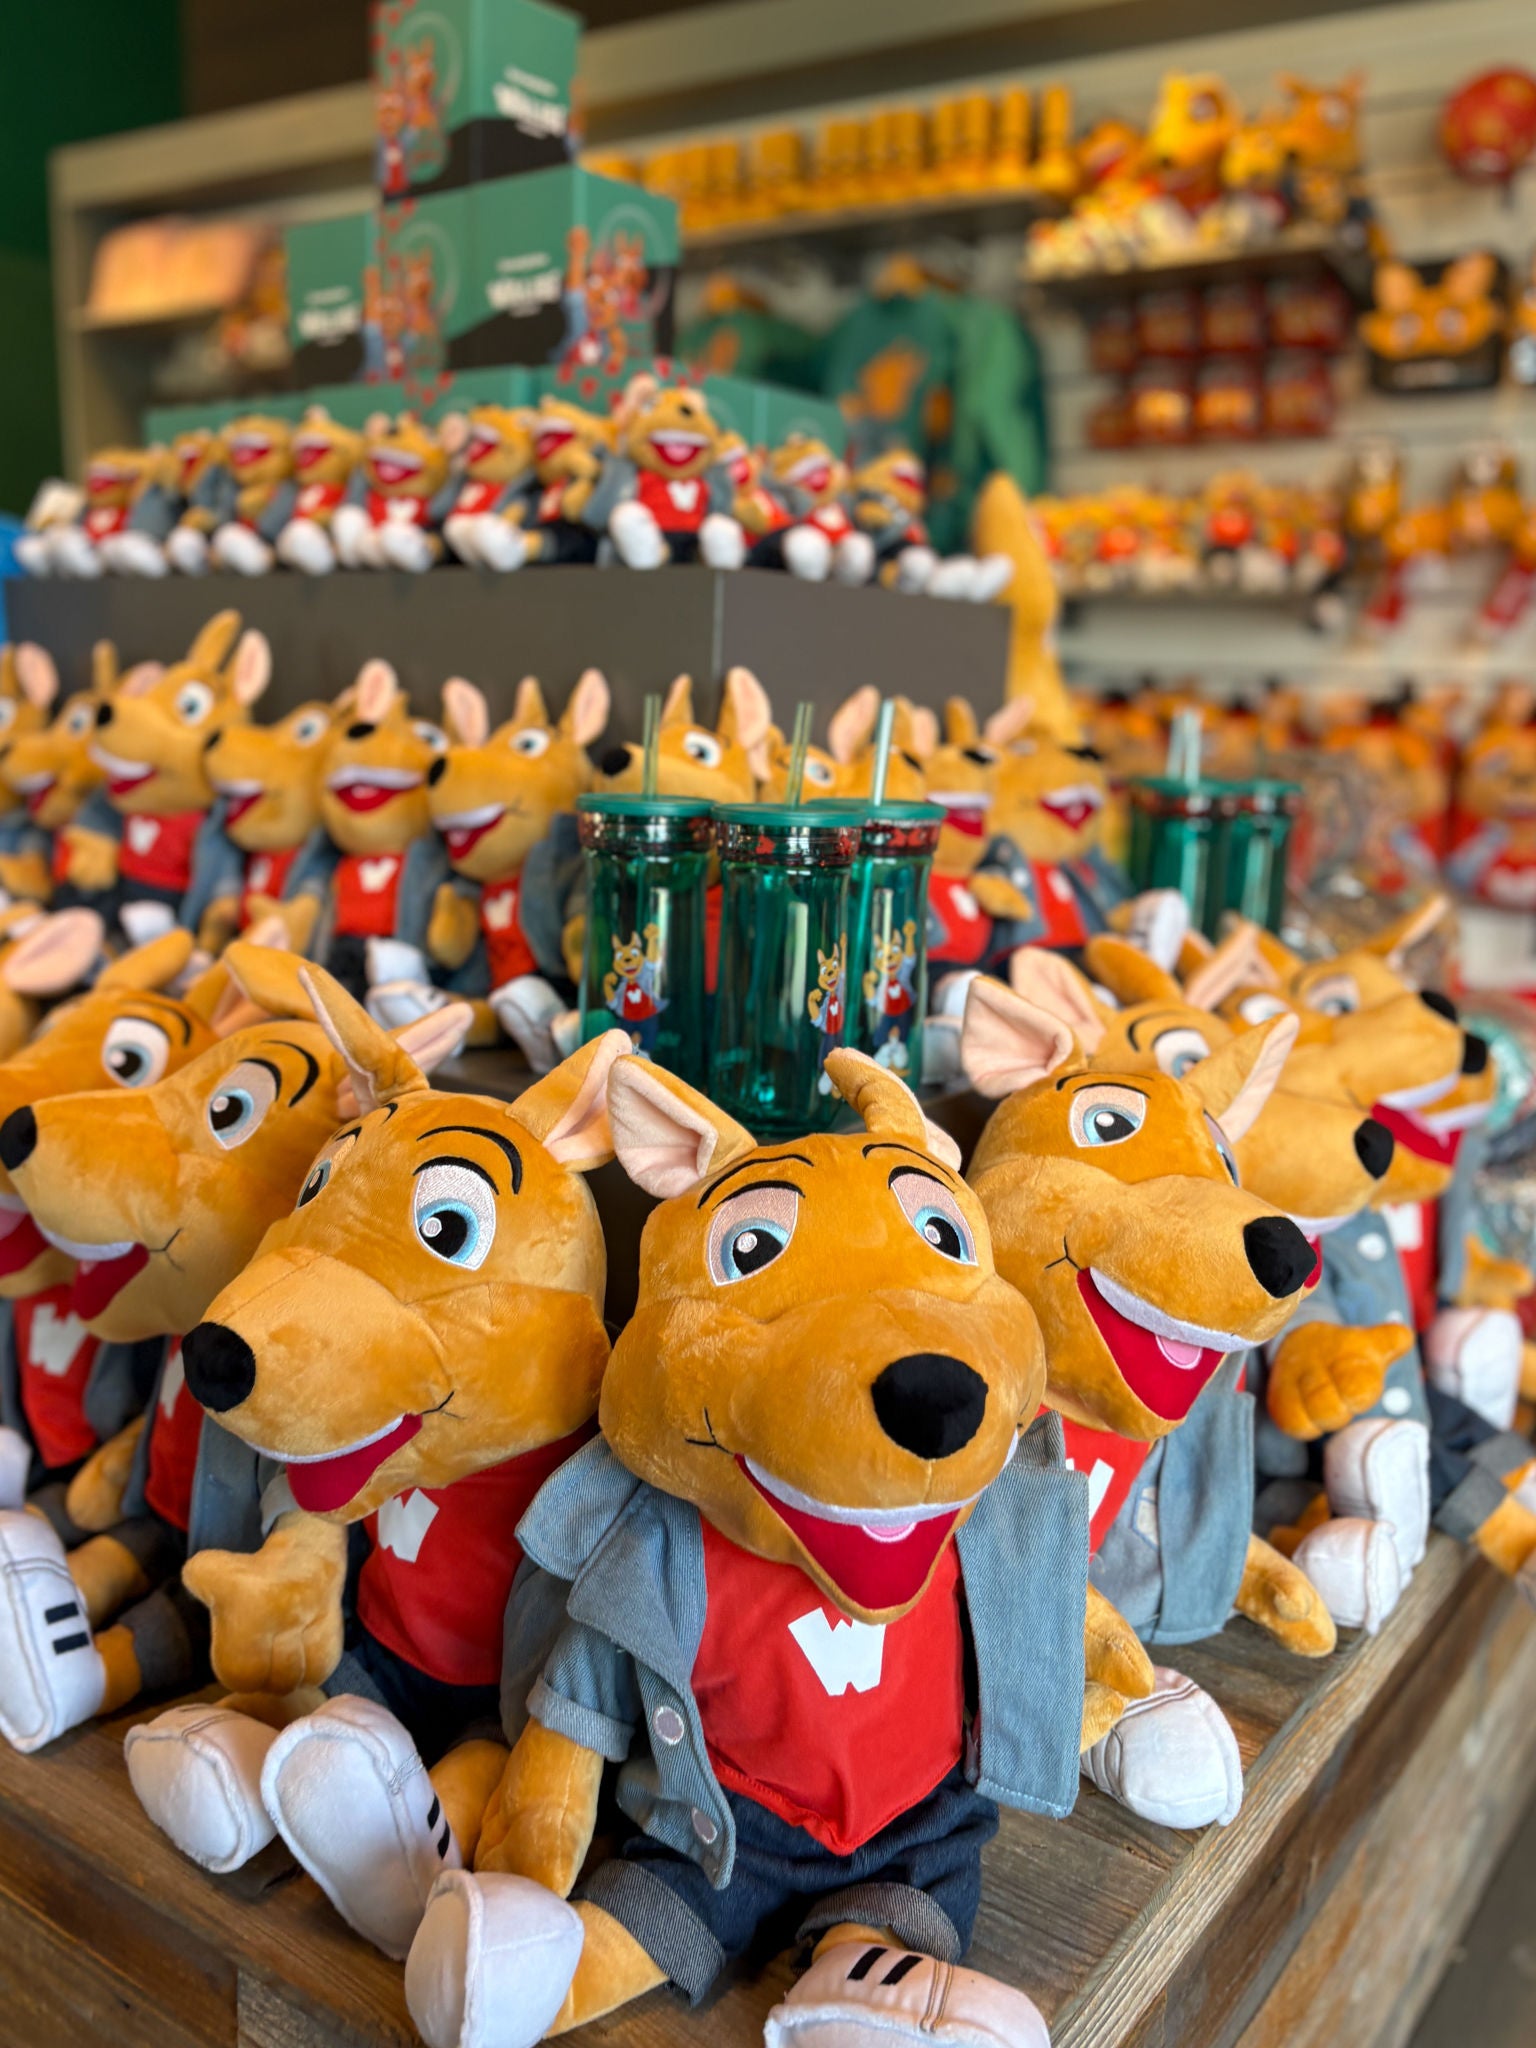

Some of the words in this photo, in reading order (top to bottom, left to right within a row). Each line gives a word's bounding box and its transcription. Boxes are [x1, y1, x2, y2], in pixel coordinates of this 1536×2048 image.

[29, 1304, 92, 1377] W
[377, 1488, 440, 1563] W
[788, 1607, 887, 1697] W
